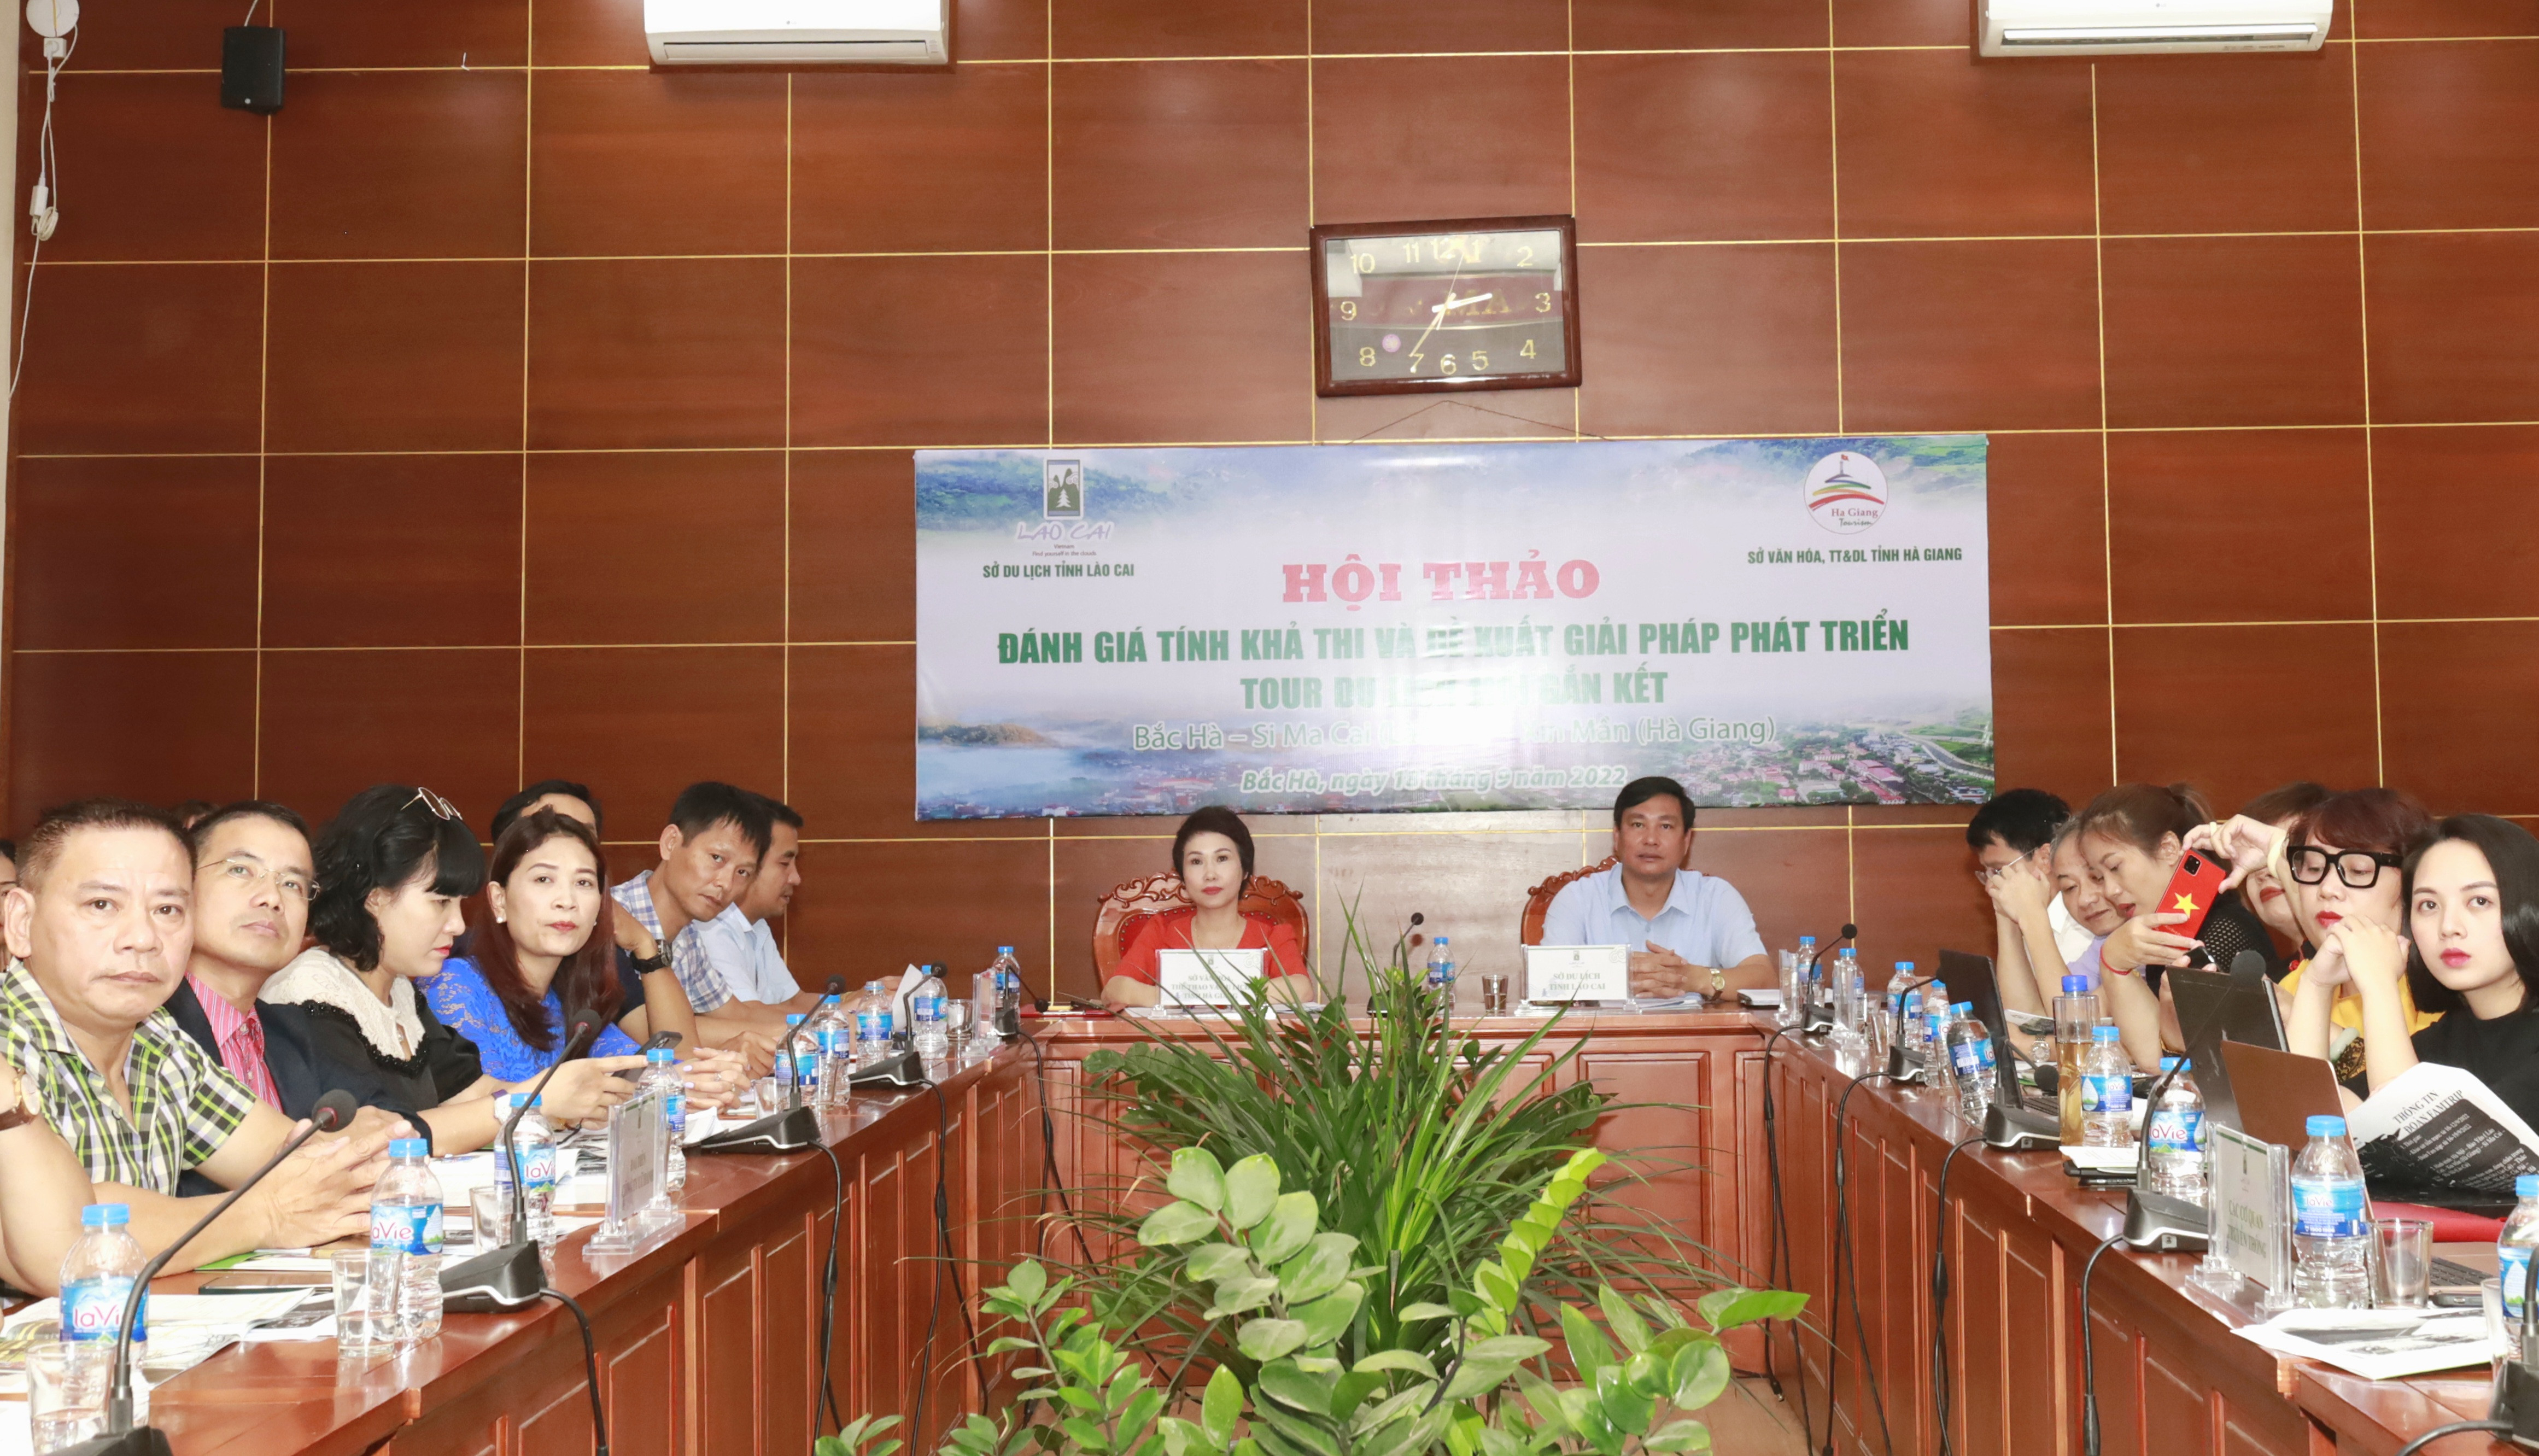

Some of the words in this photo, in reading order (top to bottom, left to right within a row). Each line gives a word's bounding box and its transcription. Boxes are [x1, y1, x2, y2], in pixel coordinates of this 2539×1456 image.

[1403, 243, 1420, 263] 11
[1430, 238, 1456, 260] 12
[1472, 239, 1482, 262] 1
[1517, 246, 1533, 267] 2
[1350, 253, 1376, 274] 10
[1340, 301, 1358, 321] 9
[1535, 293, 1552, 313] 3
[1359, 347, 1376, 366] 8
[1520, 340, 1536, 359] 4
[1410, 353, 1424, 373] 7
[1440, 353, 1457, 375] 6
[1472, 350, 1489, 371] 5
[1832, 508, 1845, 517] Ha
[1848, 508, 1879, 519] Giang
[1839, 518, 1873, 527] Tourism
[1017, 524, 1062, 540] LAO
[1070, 523, 1112, 540] CAI
[1748, 547, 1764, 564] SỞ
[1769, 548, 1793, 564] VĂN
[1797, 548, 1825, 564] HÓA,
[1829, 549, 1867, 563] TT&DL
[1871, 545, 1899, 562] TỈNH
[1904, 546, 1920, 562] HÀ
[1924, 548, 1962, 562] GIANG
[983, 561, 999, 578] SỞ
[1003, 565, 1019, 578] DU
[1023, 565, 1051, 580] LỊCH
[1055, 560, 1083, 577] TỈNH
[1087, 562, 1109, 577] LÀO
[1114, 564, 1134, 576] CAI
[1283, 554, 1401, 611] HỘI
[1423, 550, 1600, 600] THẢO
[998, 628, 1083, 664] ĐÁNH
[1094, 626, 1147, 663] GIÁ
[1156, 625, 1228, 662] TÍNH
[1241, 621, 1304, 660] KHẢ
[1313, 628, 1364, 660] THI
[1374, 622, 1416, 658] VÀ
[1474, 615, 1553, 657] XUẤT
[1564, 616, 1627, 656] GIẢI
[1639, 617, 1719, 654] PHÁP
[1731, 616, 1810, 653] PHÁT
[1821, 608, 1908, 652] TRIỂN
[1241, 677, 1322, 709] TOUR
[1334, 677, 1376, 709] DU
[1614, 662, 1668, 703] KẾT
[1135, 723, 1180, 748] Bắc
[1189, 724, 1222, 747] Hà
[1253, 723, 1274, 747] Si
[1283, 724, 1322, 746] Ma
[1331, 722, 1371, 746] Cai
[1572, 716, 1629, 741] Mần
[1640, 718, 1680, 744] (Hà
[1689, 717, 1776, 744] Giang)
[1243, 769, 1283, 792] Bắc
[1289, 770, 1325, 793] Hà,
[1331, 771, 1388, 794] ngày
[1425, 768, 1491, 791] tháng
[1495, 769, 1510, 788] 9
[1517, 768, 1565, 787] năm
[1571, 767, 1626, 785] 2022
[1553, 972, 1564, 980] SỞ
[2392, 1101, 2424, 1124] THÔNG
[2421, 1090, 2439, 1104] TIN
[2426, 1090, 2464, 1119] FAMTRIP
[2149, 1124, 2186, 1139] laVie
[2307, 1196, 2332, 1207] laVie
[372, 1221, 412, 1239] aVie
[75, 1305, 120, 1328] laVi
